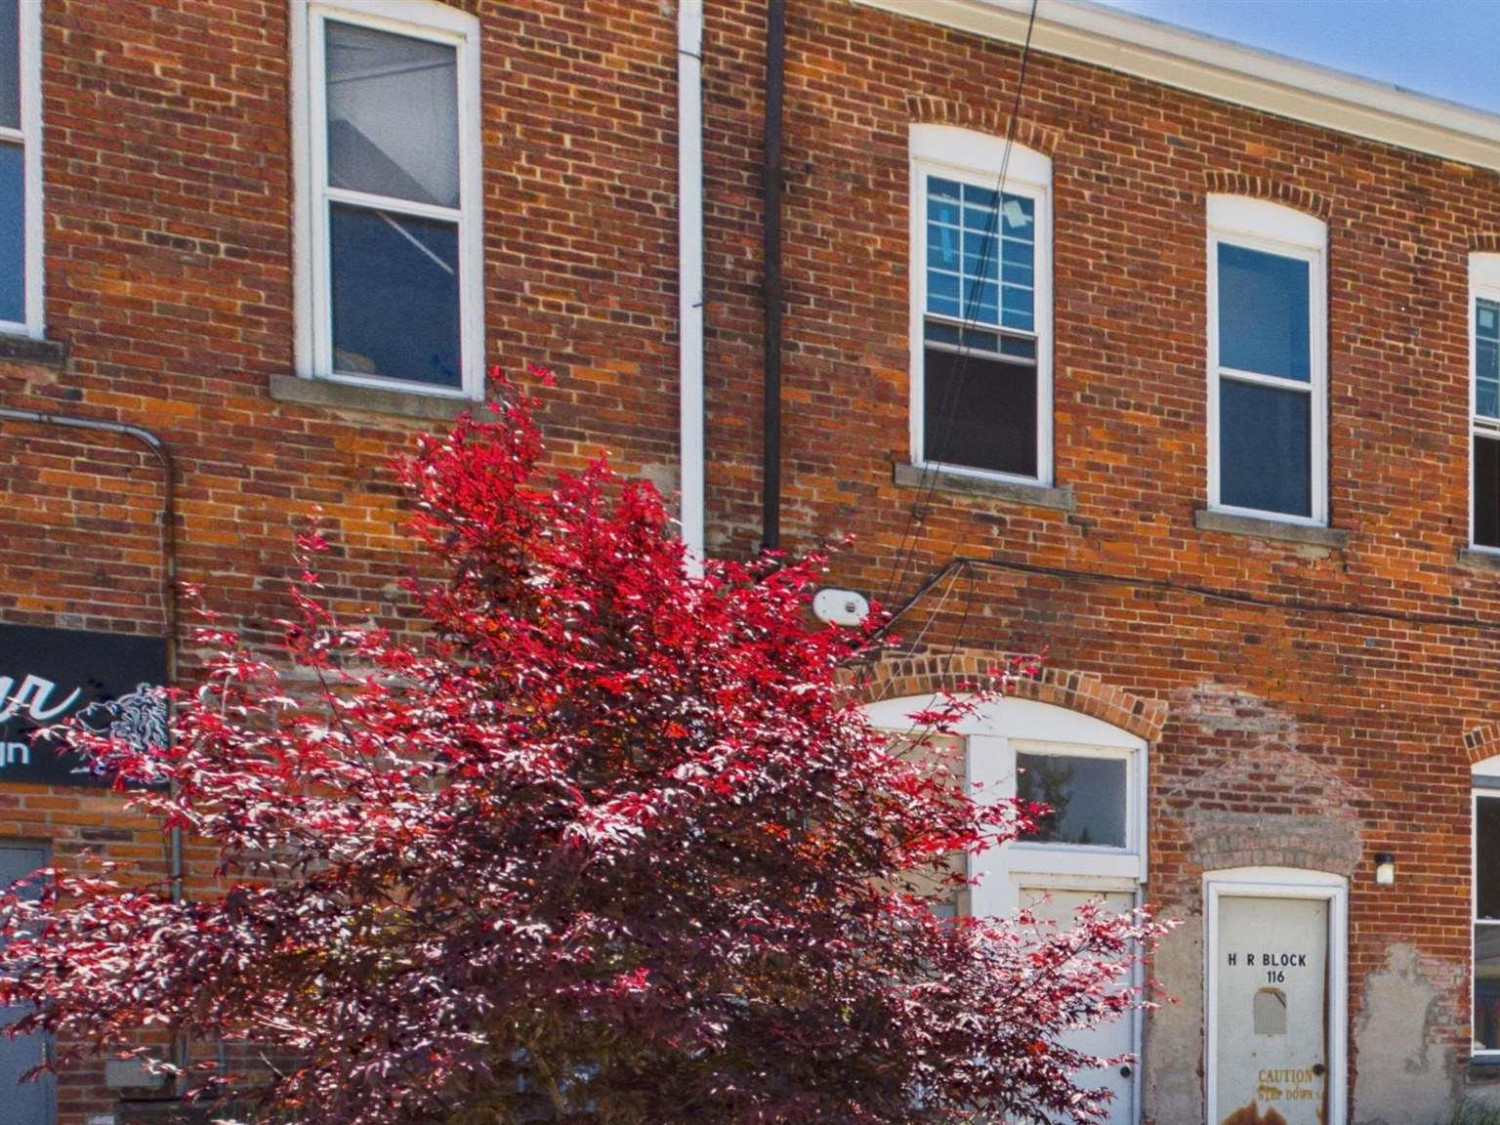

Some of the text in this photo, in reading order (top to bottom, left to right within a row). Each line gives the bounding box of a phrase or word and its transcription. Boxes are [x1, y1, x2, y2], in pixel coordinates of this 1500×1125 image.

[1228, 953, 1307, 967] H R BLOCK
[1267, 970, 1285, 983] 116
[1258, 1069, 1313, 1083] CAUTION
